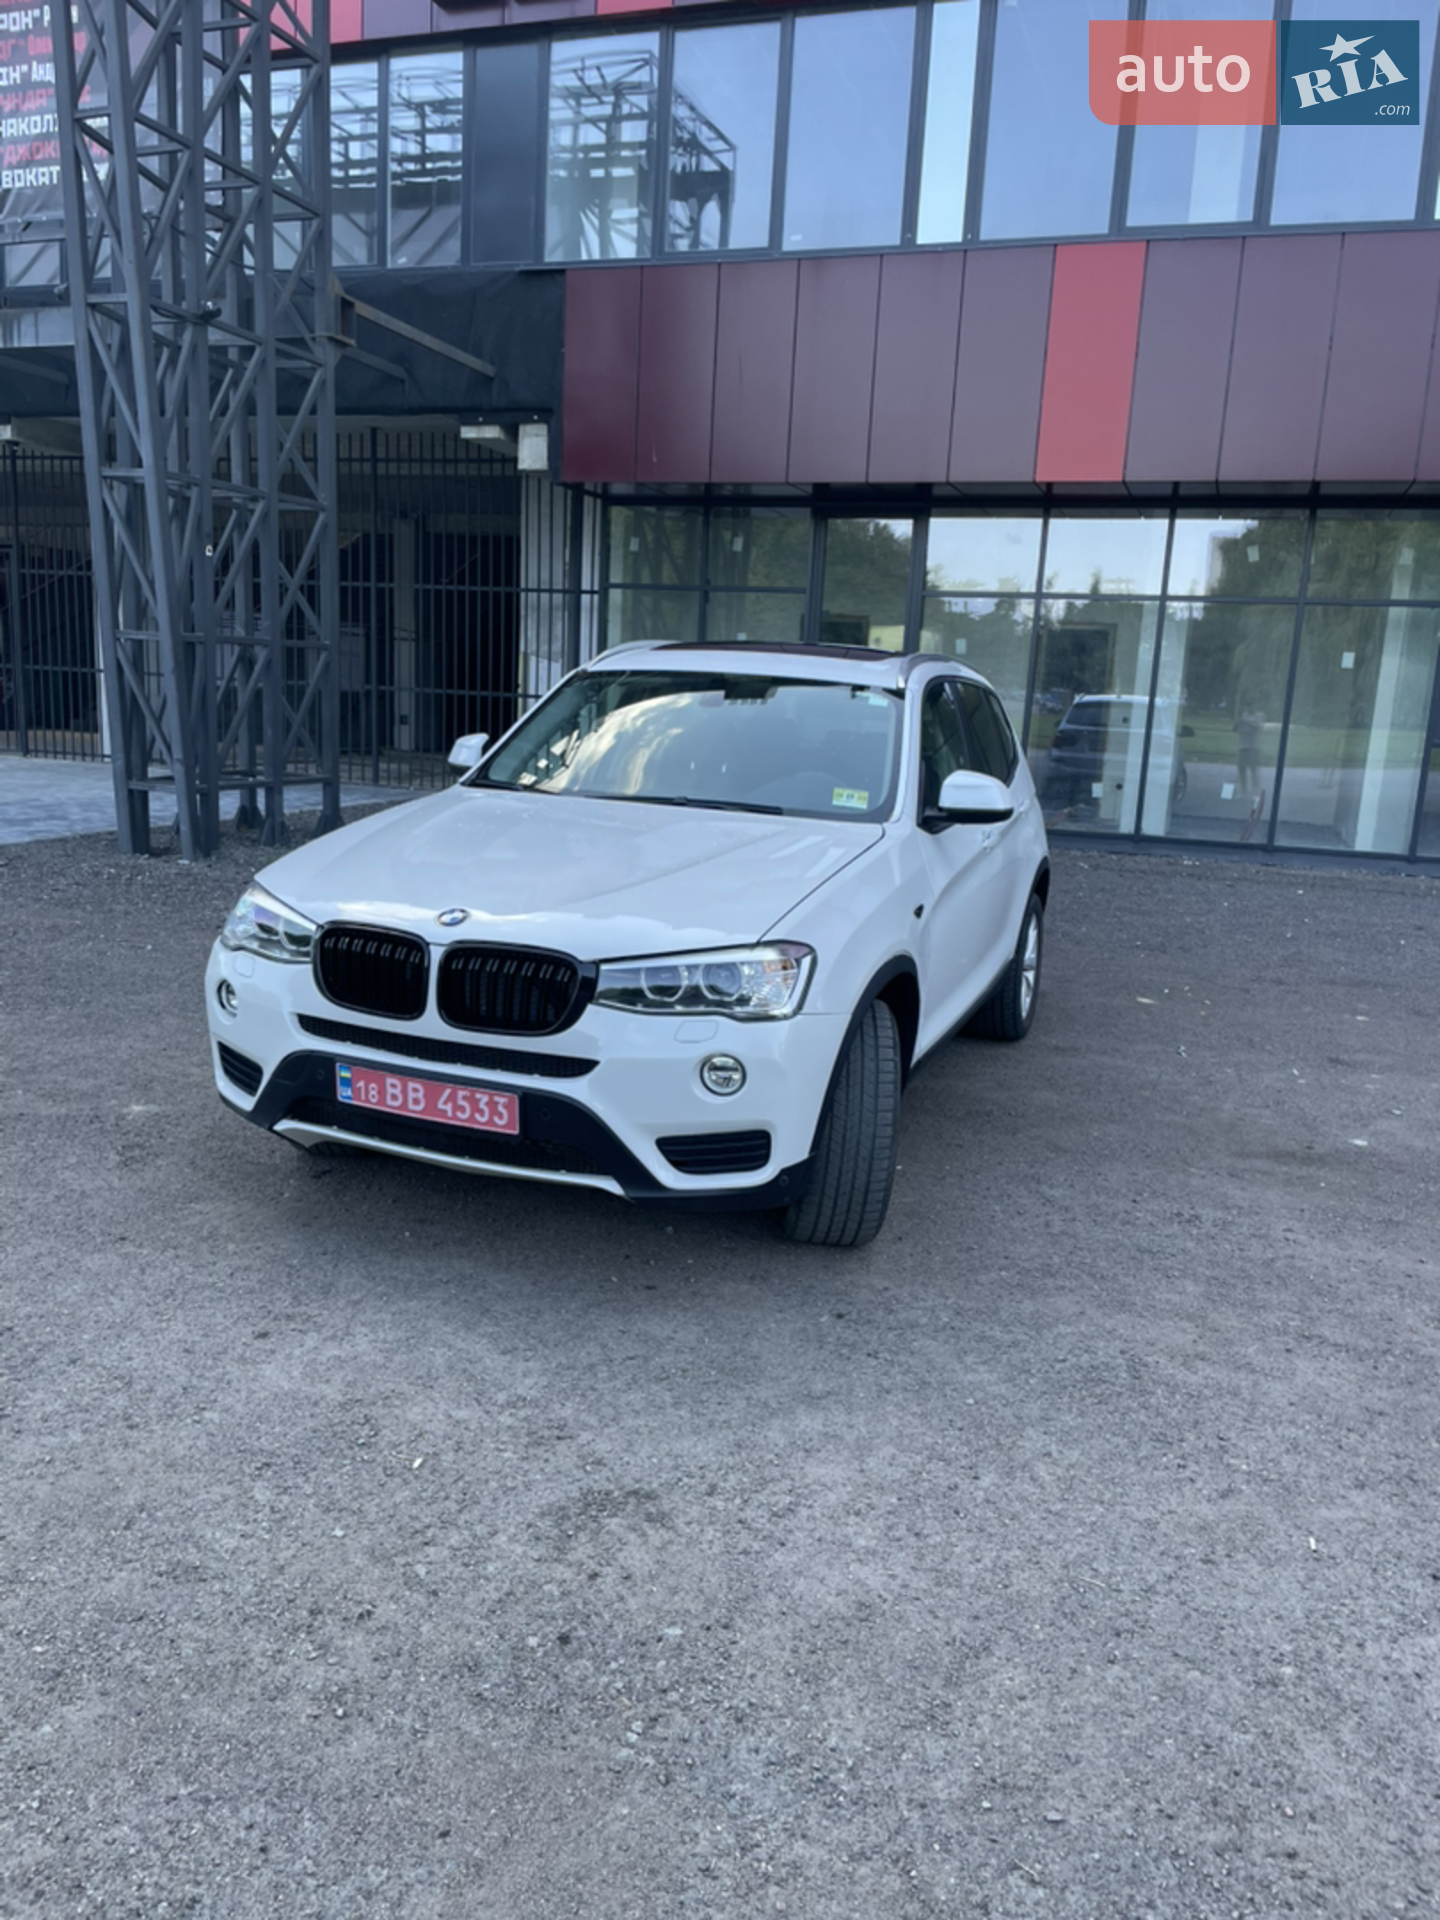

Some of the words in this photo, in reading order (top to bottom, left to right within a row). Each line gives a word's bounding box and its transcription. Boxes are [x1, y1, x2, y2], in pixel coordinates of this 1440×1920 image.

[0, 165, 60, 190] ВОКАТ
[355, 1080, 379, 1104] 18
[385, 1077, 426, 1112] BB
[437, 1087, 509, 1126] 4533
